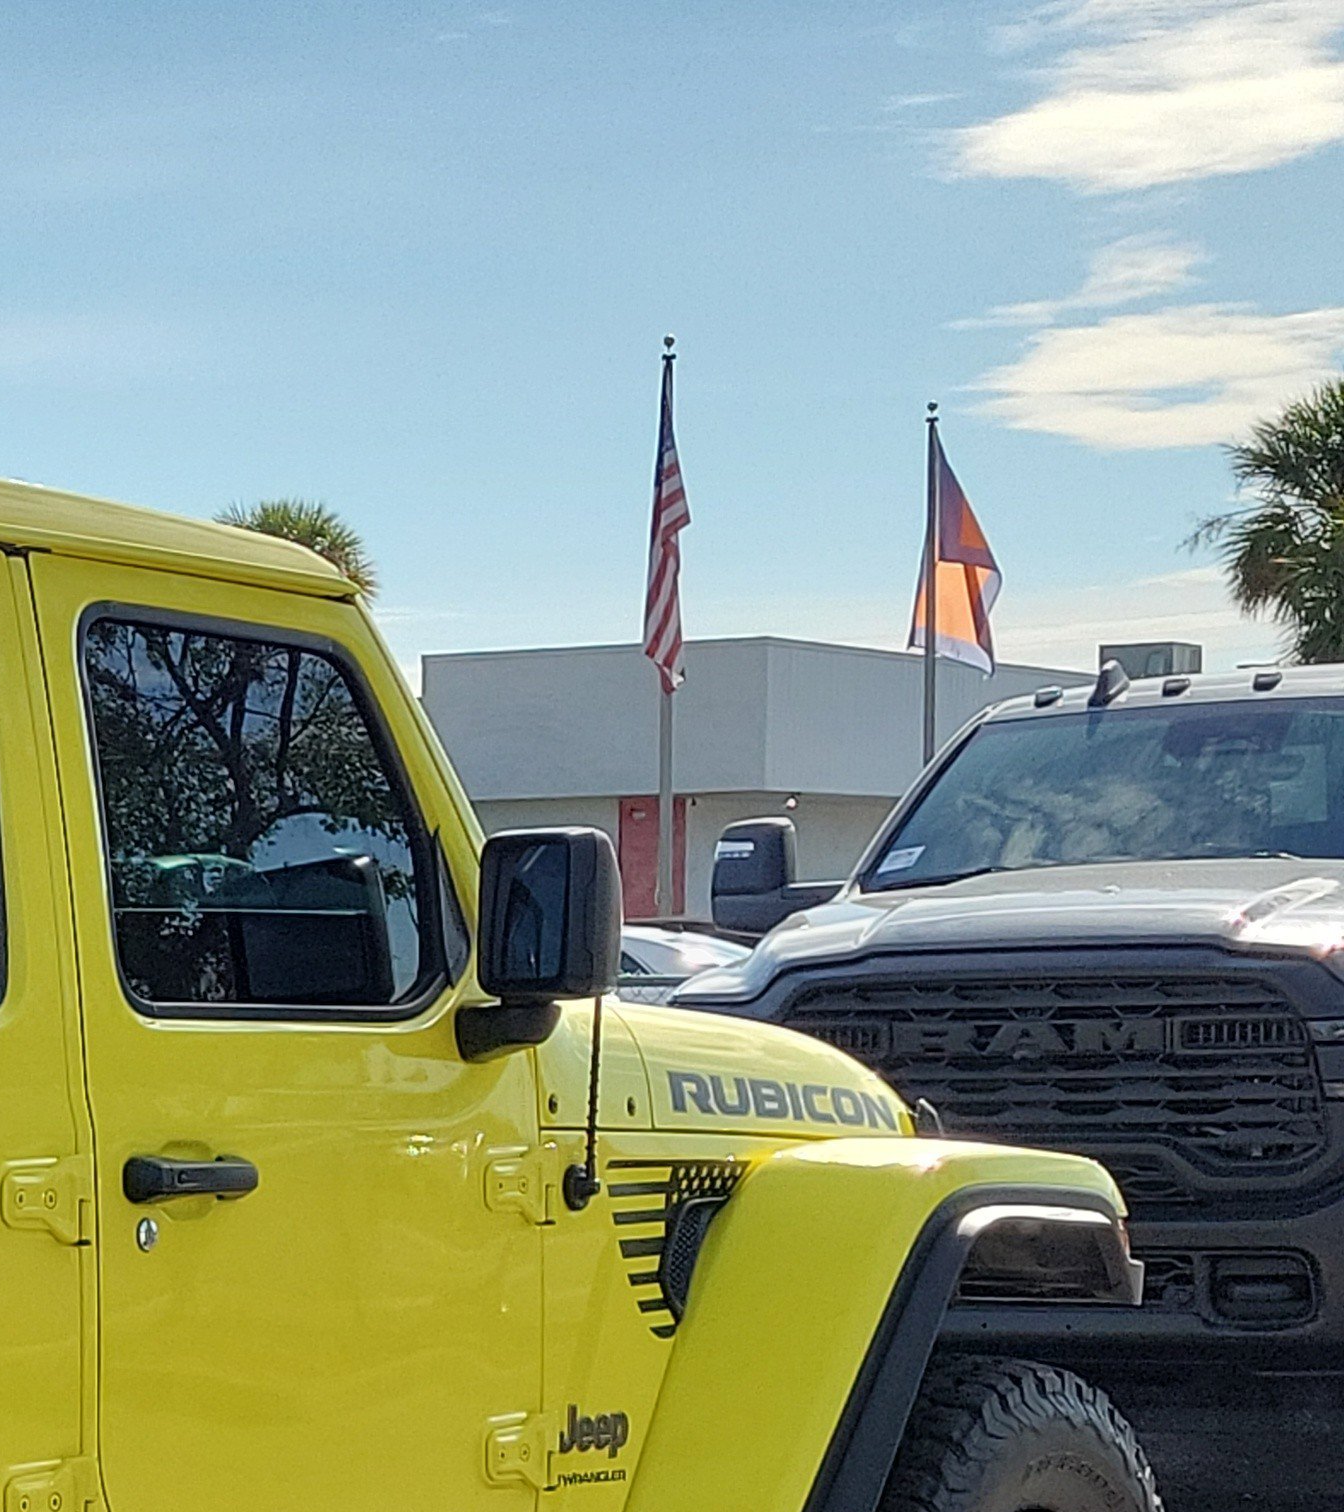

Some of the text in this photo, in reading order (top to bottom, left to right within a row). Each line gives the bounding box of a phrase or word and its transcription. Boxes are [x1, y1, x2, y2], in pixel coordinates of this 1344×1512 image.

[893, 1020, 1162, 1052] RAM
[667, 1070, 898, 1131] RUBICON
[559, 1403, 629, 1459] Jeep
